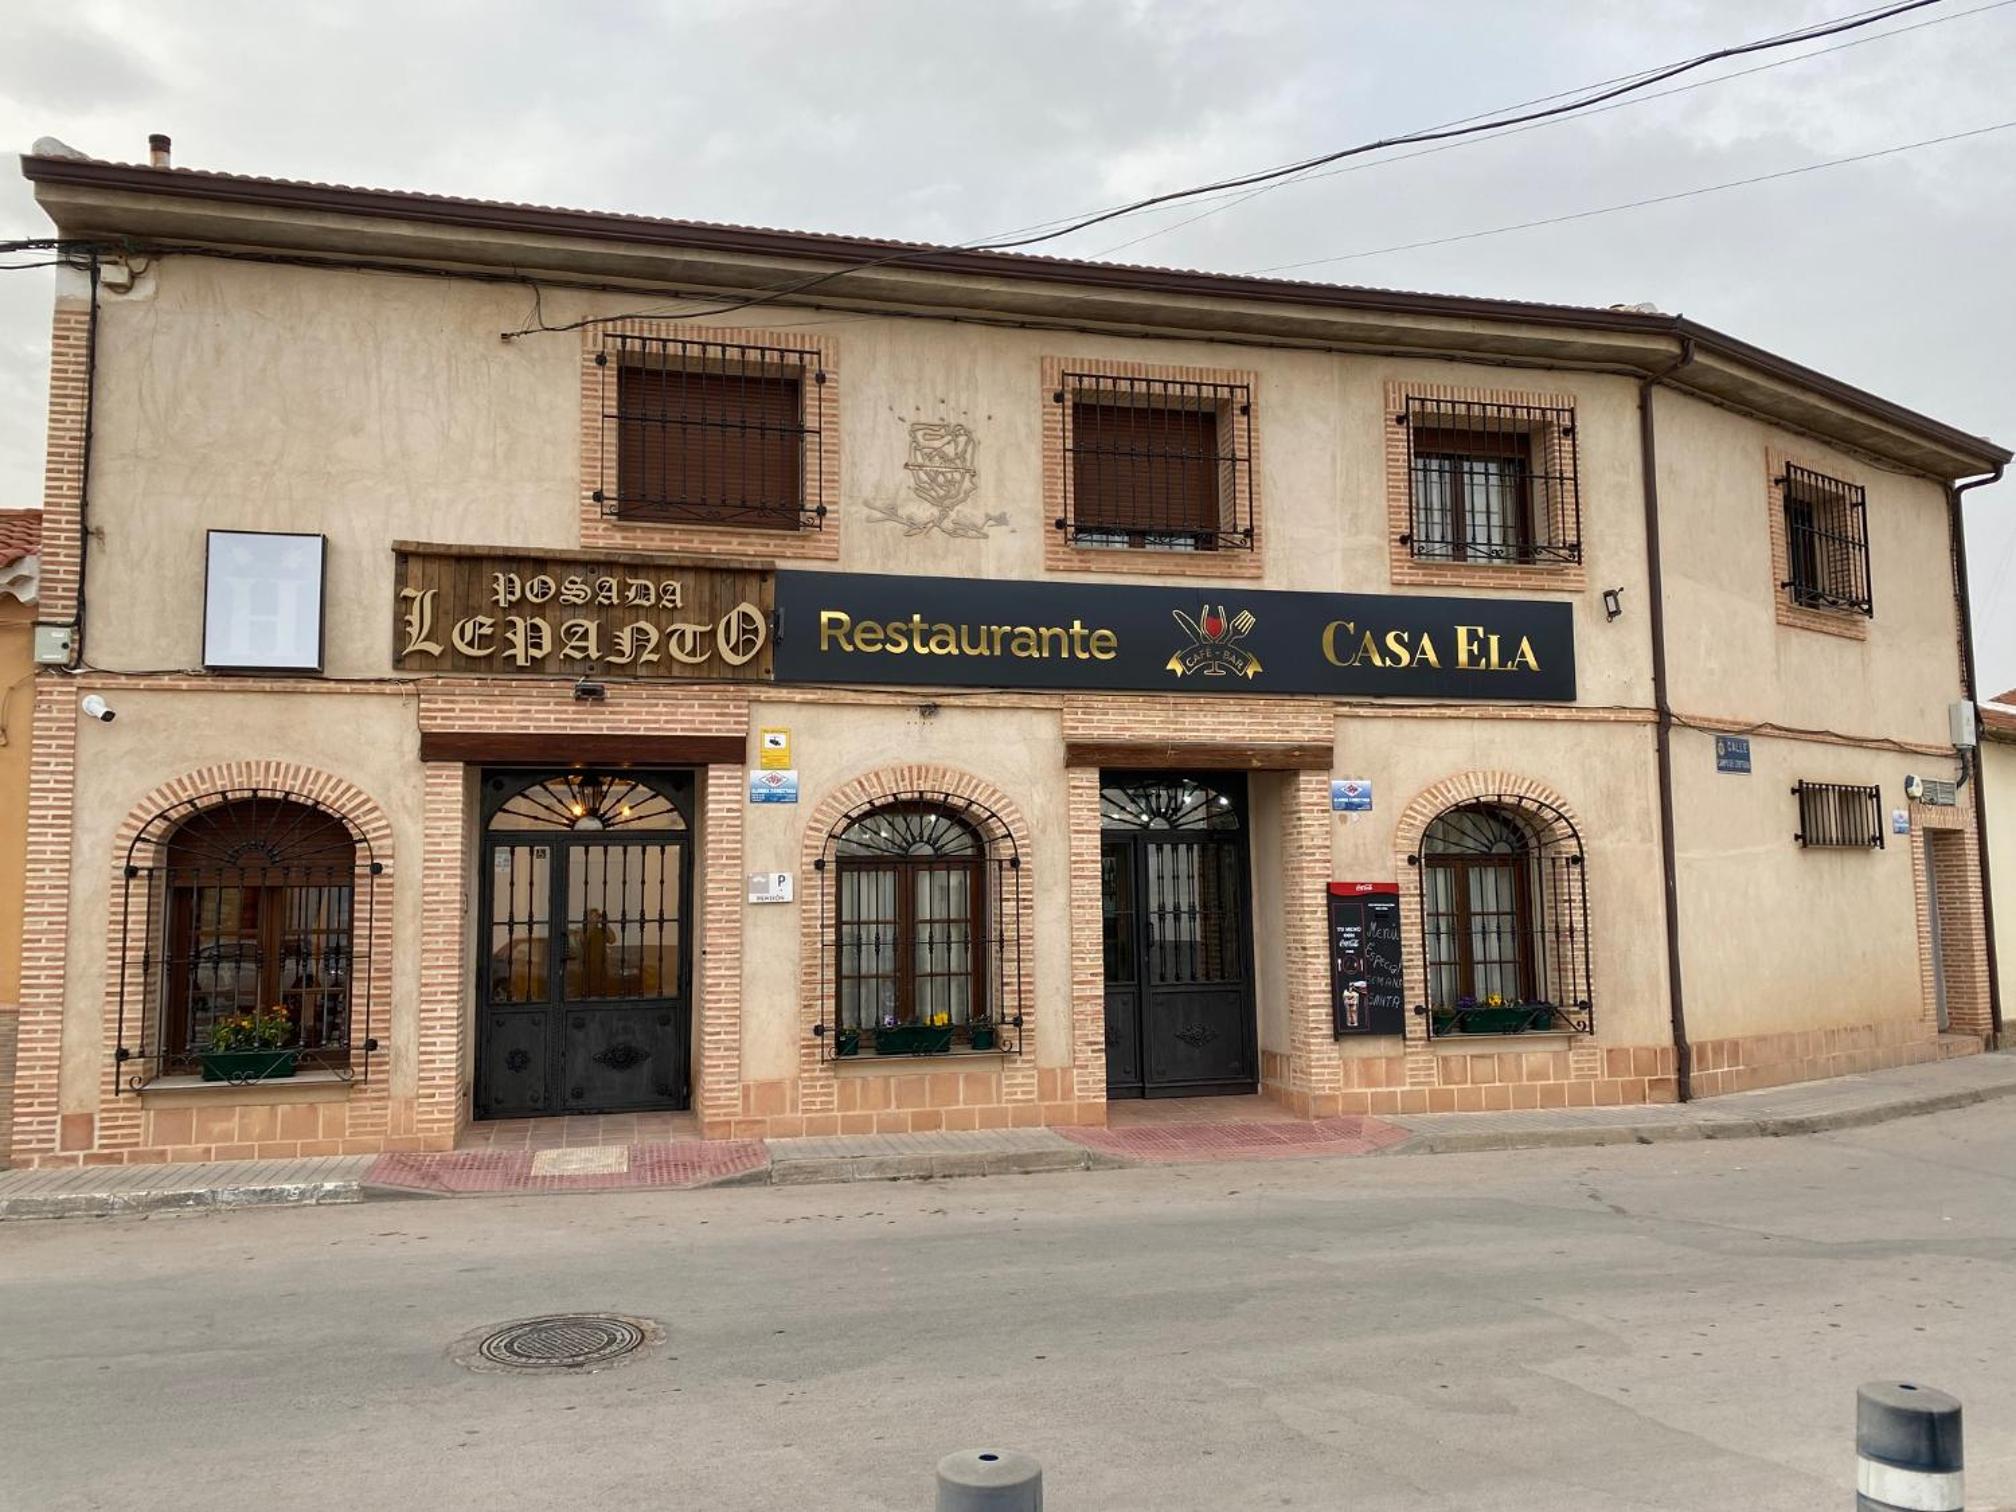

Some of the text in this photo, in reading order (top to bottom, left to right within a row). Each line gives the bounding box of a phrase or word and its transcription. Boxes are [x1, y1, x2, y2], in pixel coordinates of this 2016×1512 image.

[491, 572, 683, 609] POSADA
[400, 586, 767, 667] LEPANTO
[820, 610, 1118, 661] Restaurante
[1322, 620, 1541, 672] CASA ELA
[1223, 650, 1244, 670] BAR
[777, 874, 786, 887] P
